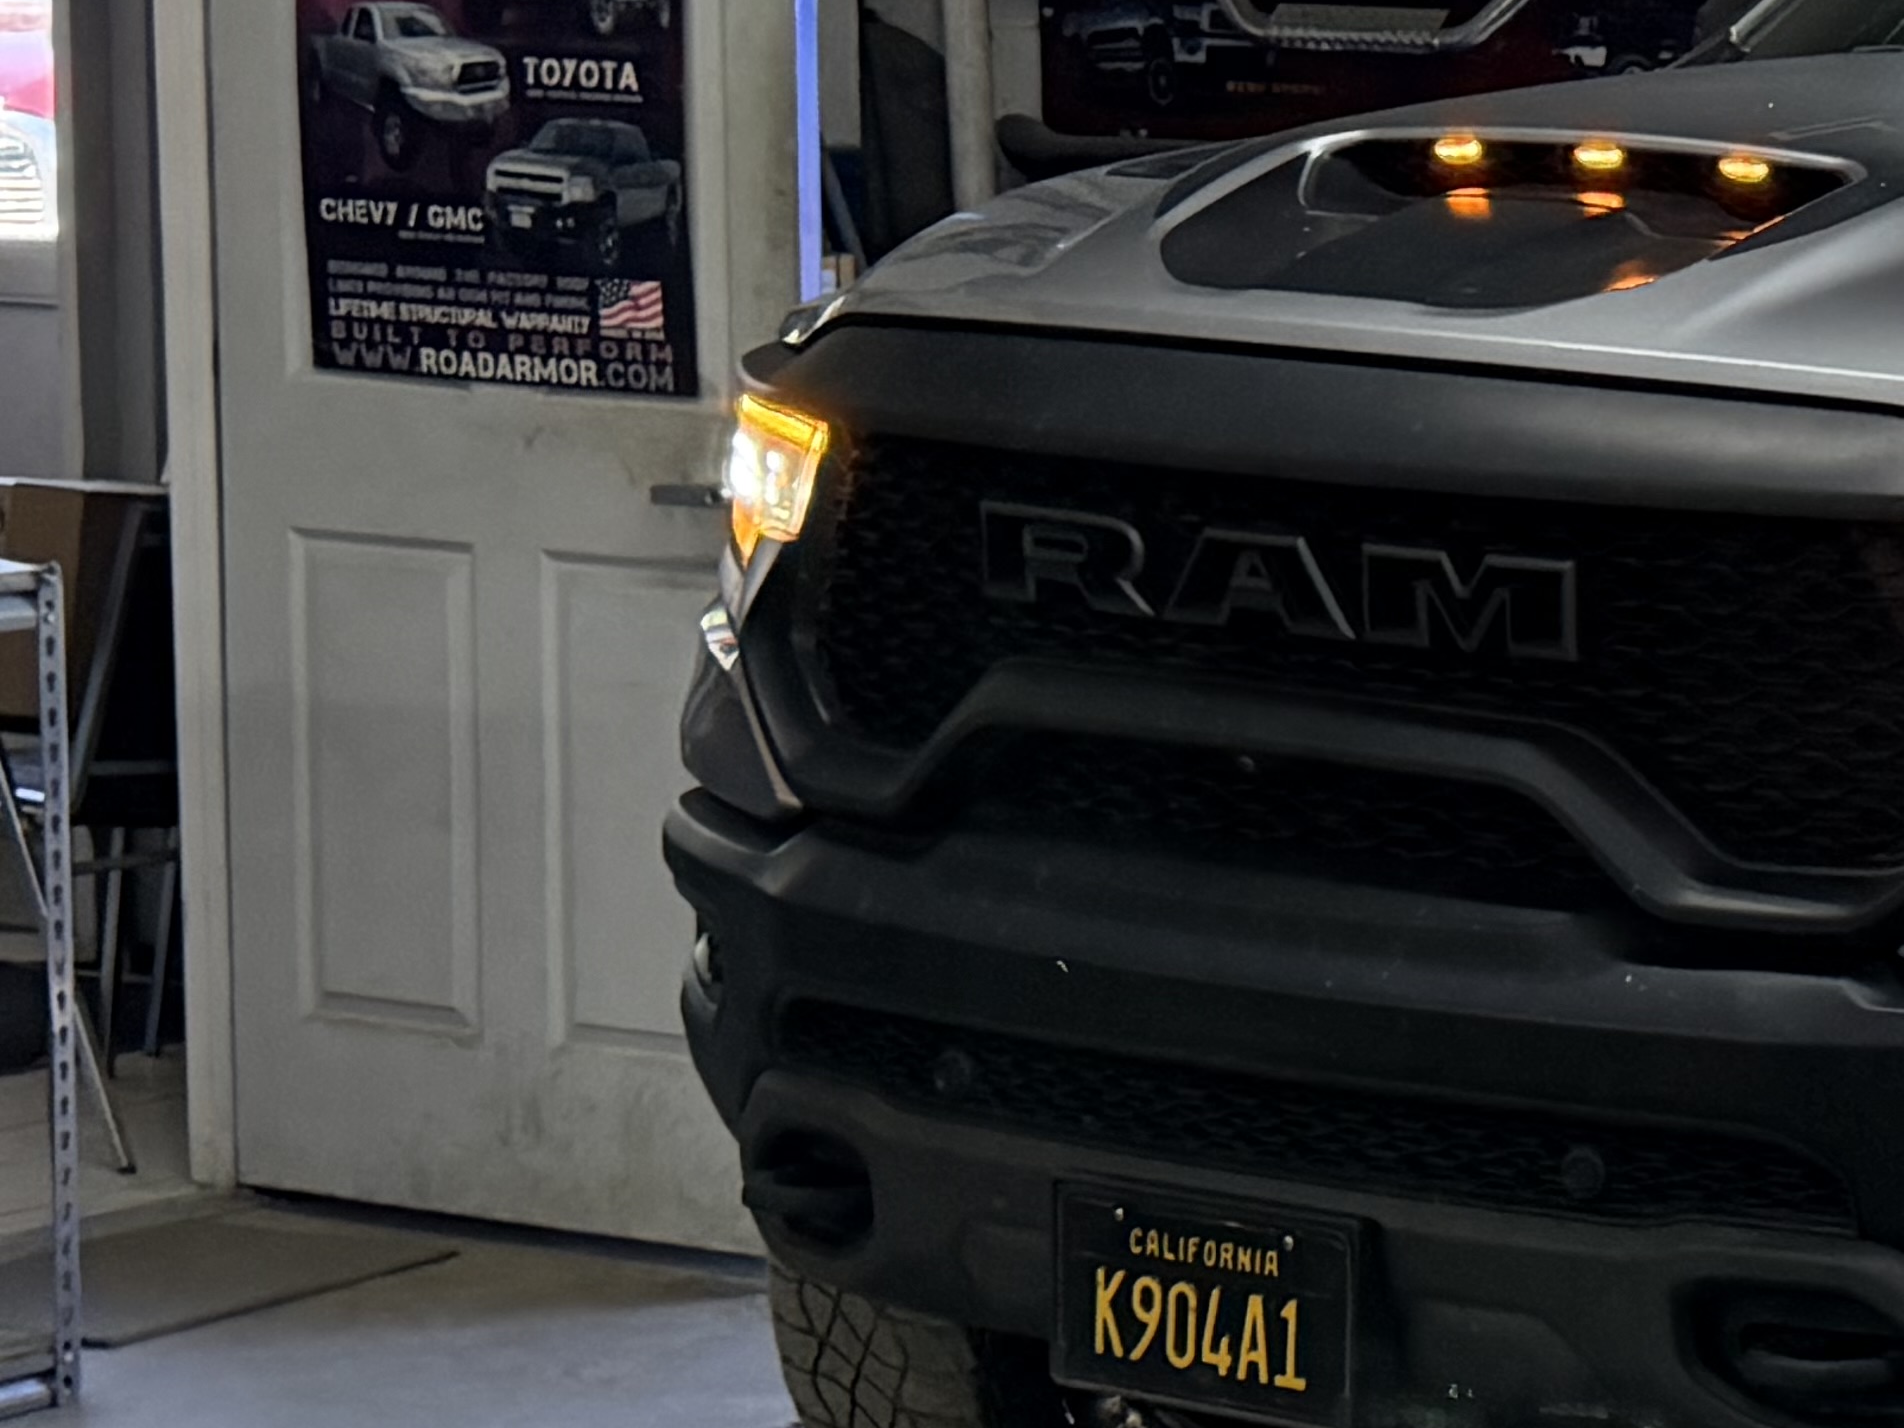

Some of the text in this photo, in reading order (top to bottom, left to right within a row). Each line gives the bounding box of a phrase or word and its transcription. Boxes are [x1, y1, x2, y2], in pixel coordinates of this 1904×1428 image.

[523, 56, 639, 92] TOYOTA
[319, 198, 397, 227] CHEVY
[427, 206, 485, 231] GMC
[330, 320, 422, 345] BUILT
[446, 329, 486, 349] TO
[508, 333, 674, 363] PERFORM
[980, 499, 1579, 662] RAM
[1129, 1227, 1279, 1278] CALIFORNIA
[1095, 1265, 1307, 1393] K904A1
